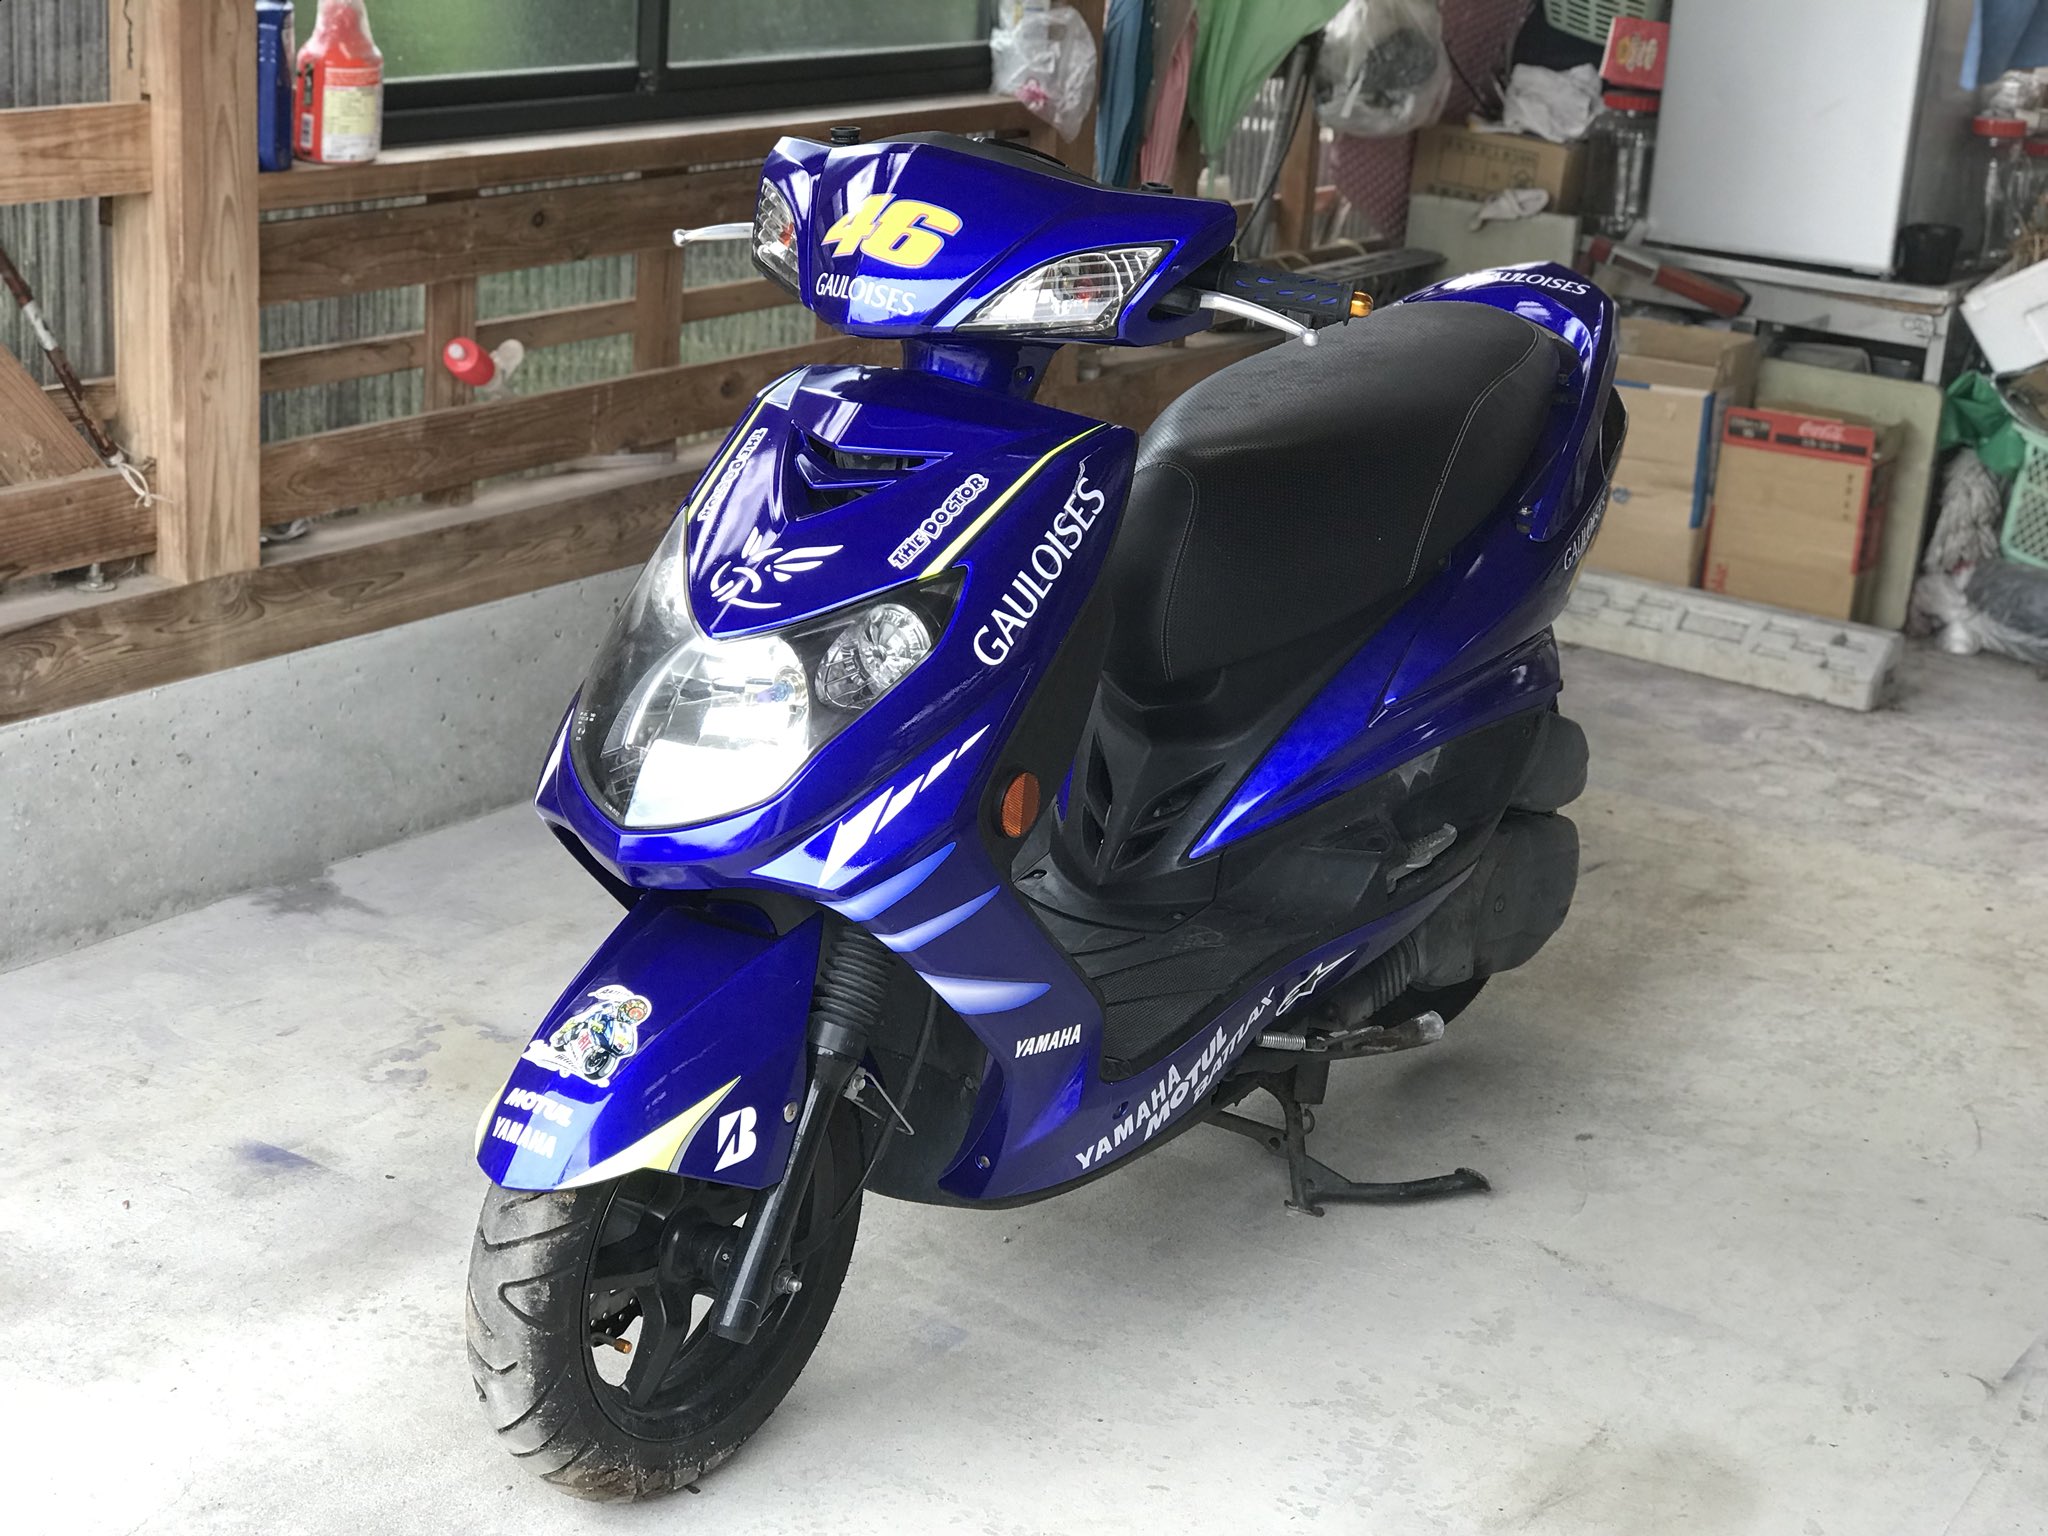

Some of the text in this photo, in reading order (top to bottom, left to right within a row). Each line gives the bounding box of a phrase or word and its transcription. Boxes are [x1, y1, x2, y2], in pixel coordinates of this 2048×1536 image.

[820, 193, 964, 269] 46
[815, 272, 917, 316] GAULOISES
[1493, 271, 1591, 295] ULOISES
[890, 475, 986, 567] THE DOCTOR
[973, 476, 1106, 666] GAULOISES
[1014, 1023, 1082, 1059] YAMAHA
[503, 1087, 575, 1128] MOTUL
[1144, 1026, 1227, 1141] MOTUL
[492, 1116, 557, 1159] YAMAHA
[1075, 1064, 1181, 1170] YAMAHA
